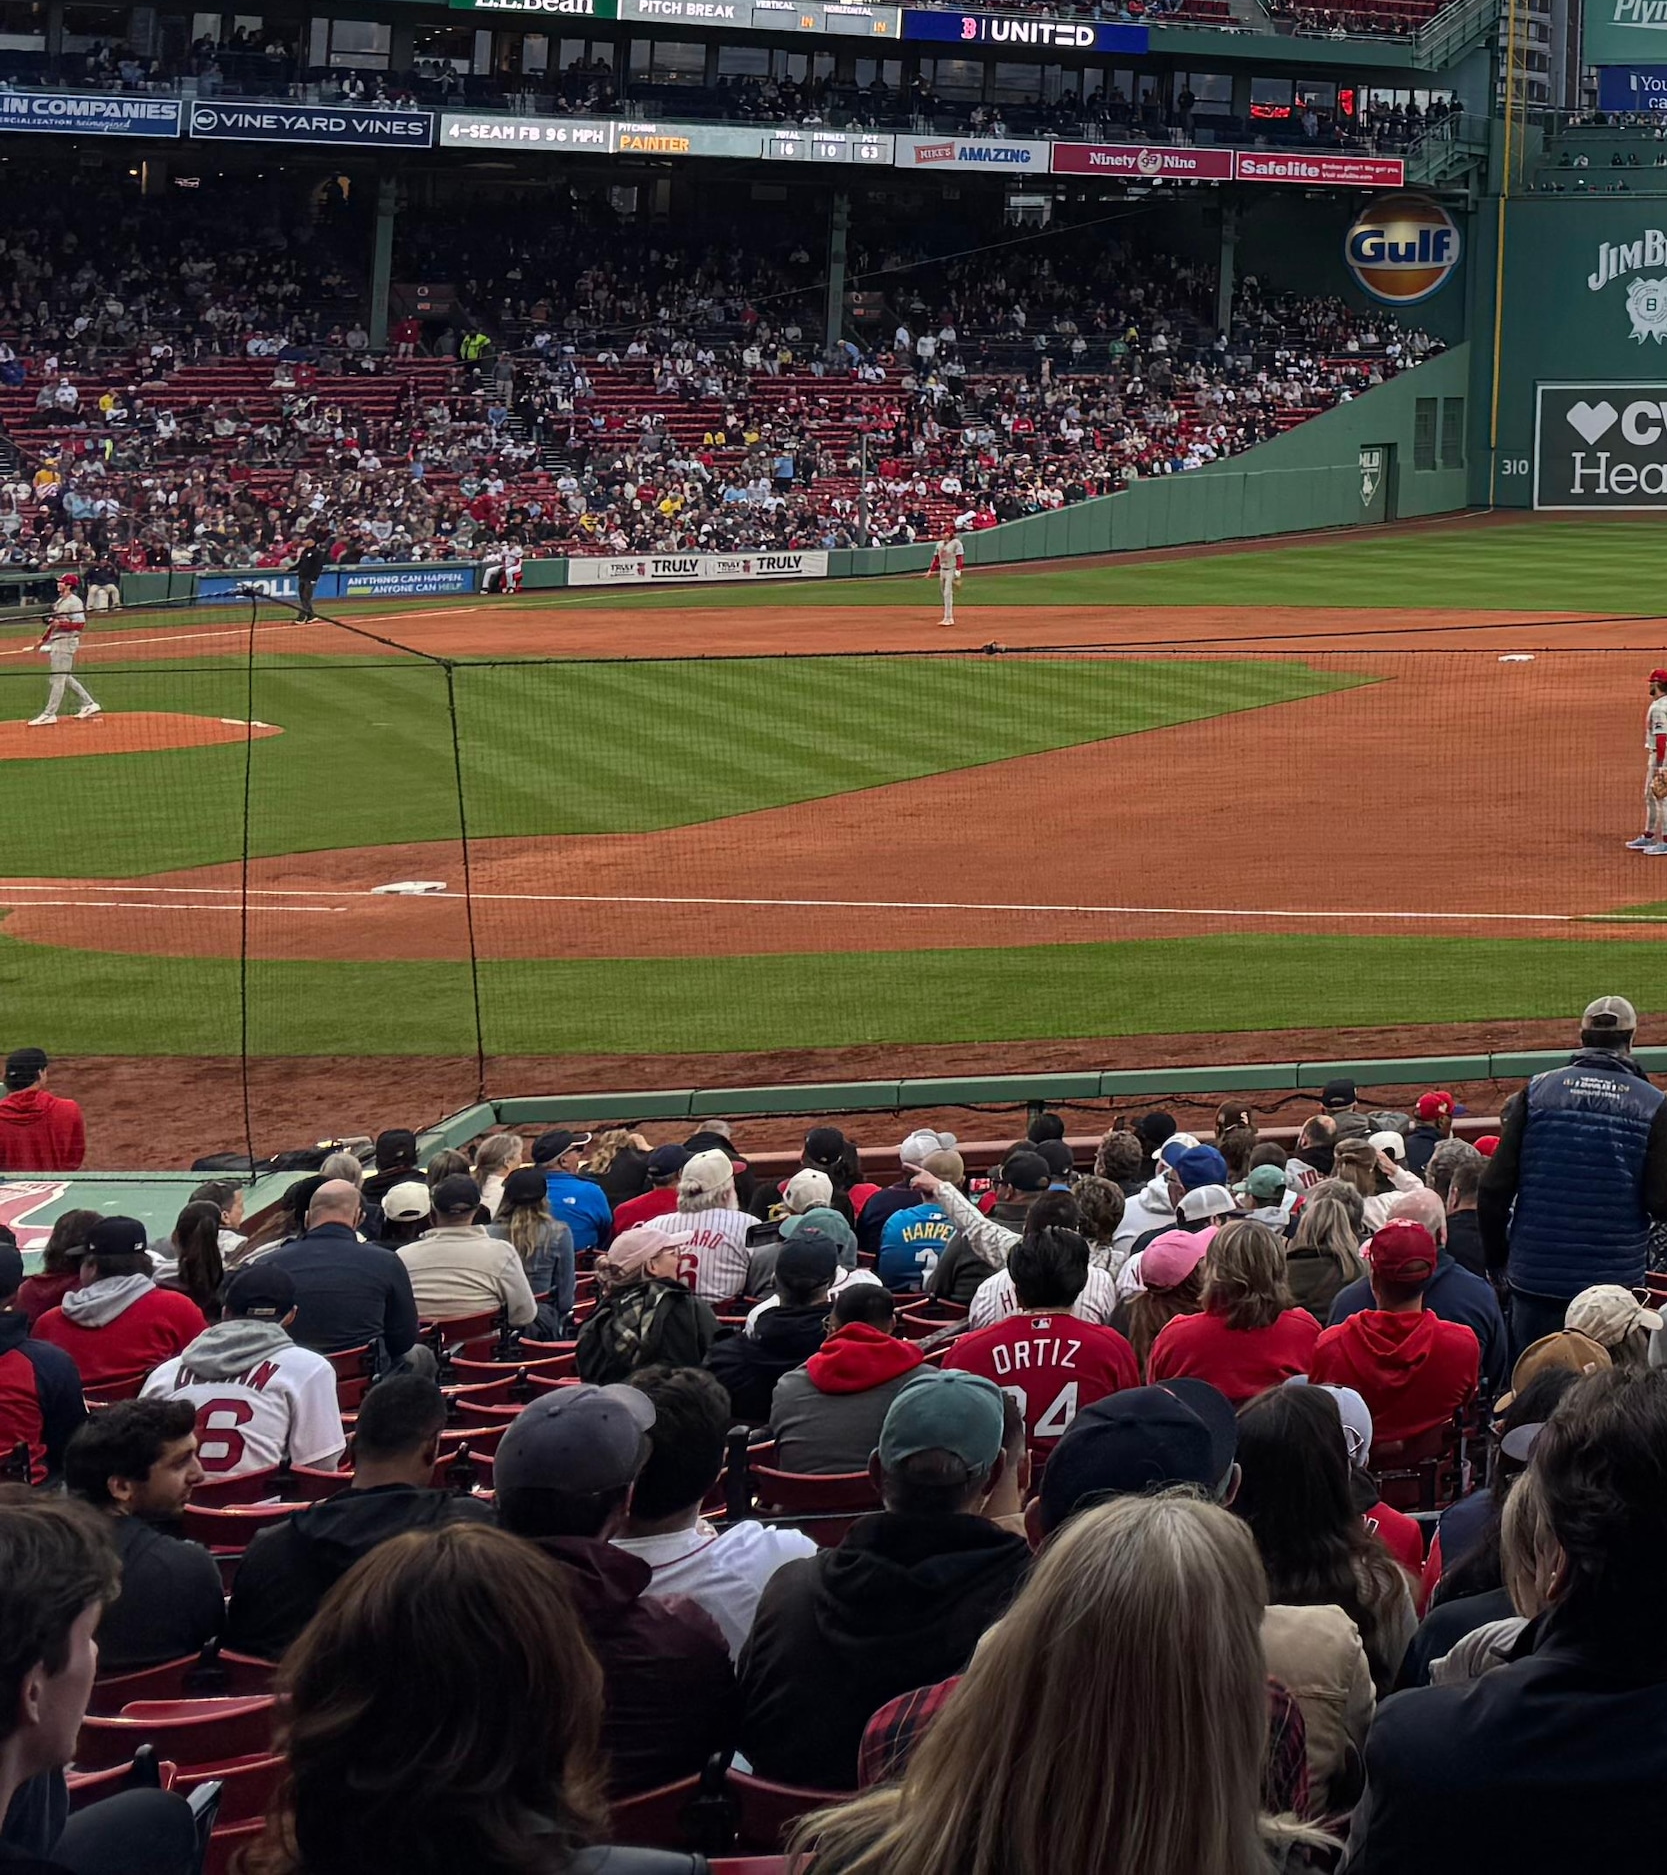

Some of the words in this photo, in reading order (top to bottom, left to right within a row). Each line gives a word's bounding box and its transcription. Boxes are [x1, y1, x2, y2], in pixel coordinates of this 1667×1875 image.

[638, 0, 682, 15] PITCH
[685, 3, 735, 19] BREAK
[991, 21, 1096, 48] UNITED
[36, 98, 178, 120] COMPANIES
[219, 113, 347, 133] VINEYARD
[351, 117, 424, 137] VINES
[620, 135, 690, 152] PAINTER
[958, 146, 1031, 163] AMAZING
[1089, 151, 1136, 170] Ninety
[1163, 155, 1197, 170] Nine
[1241, 159, 1320, 178] Safelite
[1350, 229, 1453, 265] Gulf
[1501, 460, 1529, 475] 310
[651, 559, 699, 574] TRULY
[757, 555, 802, 571] TRULY
[347, 575, 399, 586] ANYTHING
[400, 574, 423, 584] CAN
[372, 584, 415, 595] ANYONE
[416, 583, 438, 593] CAN
[902, 1221, 955, 1243] HARPE
[992, 1338, 1082, 1375] ORTIZ
[197, 1398, 254, 1473] 6
